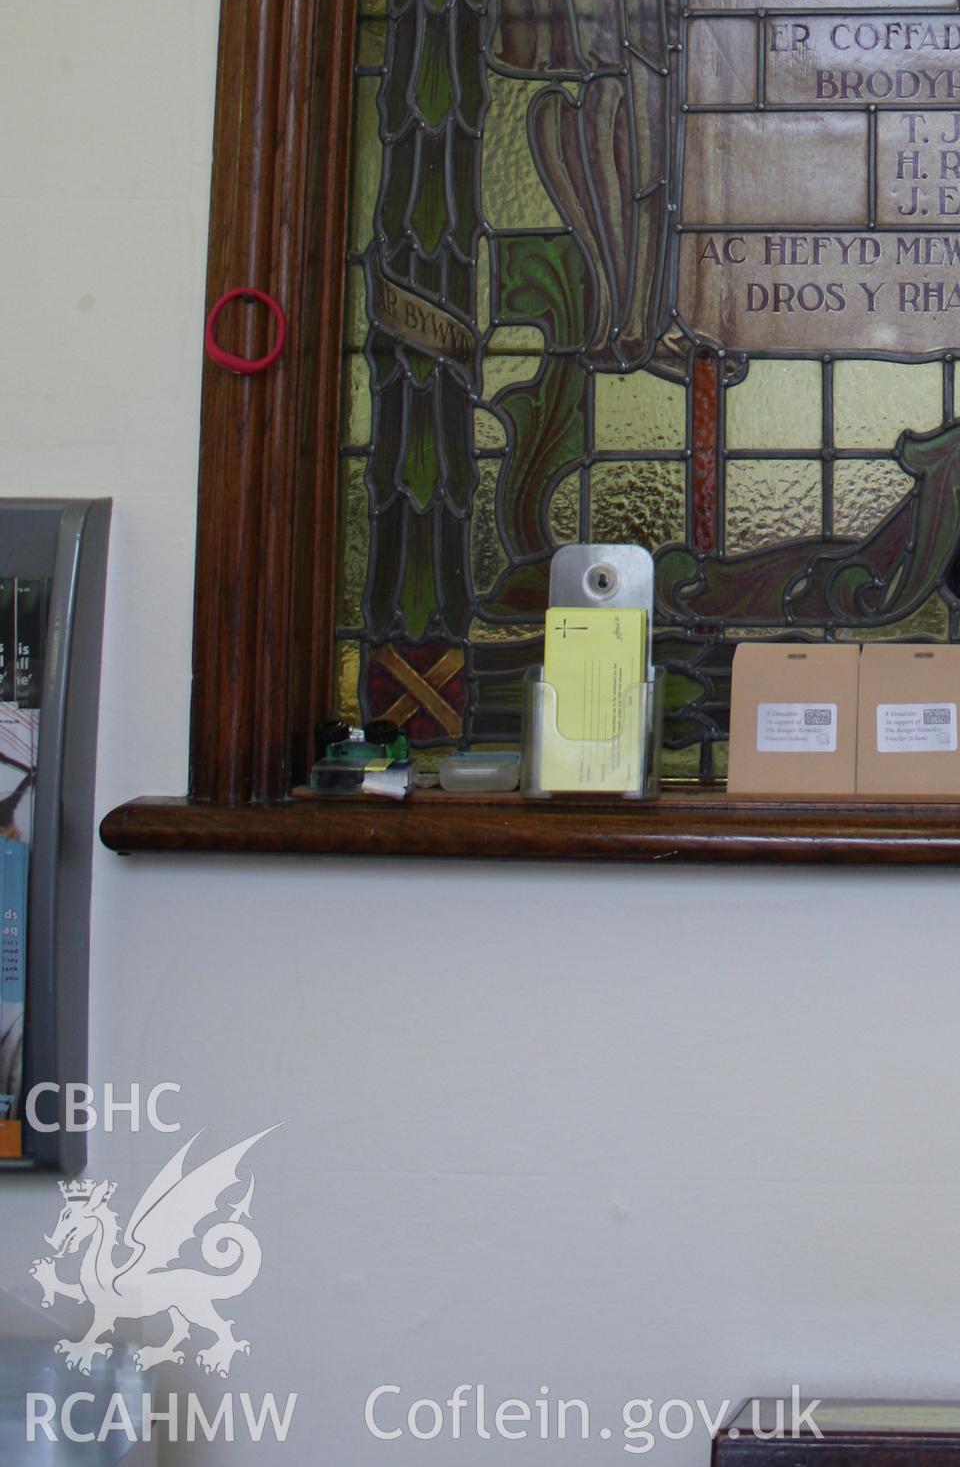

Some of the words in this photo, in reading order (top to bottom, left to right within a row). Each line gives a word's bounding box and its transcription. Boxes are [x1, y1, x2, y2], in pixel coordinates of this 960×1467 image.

[769, 23, 814, 51] ER
[900, 113, 930, 144] T.
[896, 149, 929, 180] H.
[699, 236, 747, 266] AC
[763, 236, 882, 266] HEFYD
[745, 282, 847, 313] DROS
[858, 282, 886, 312] Y
